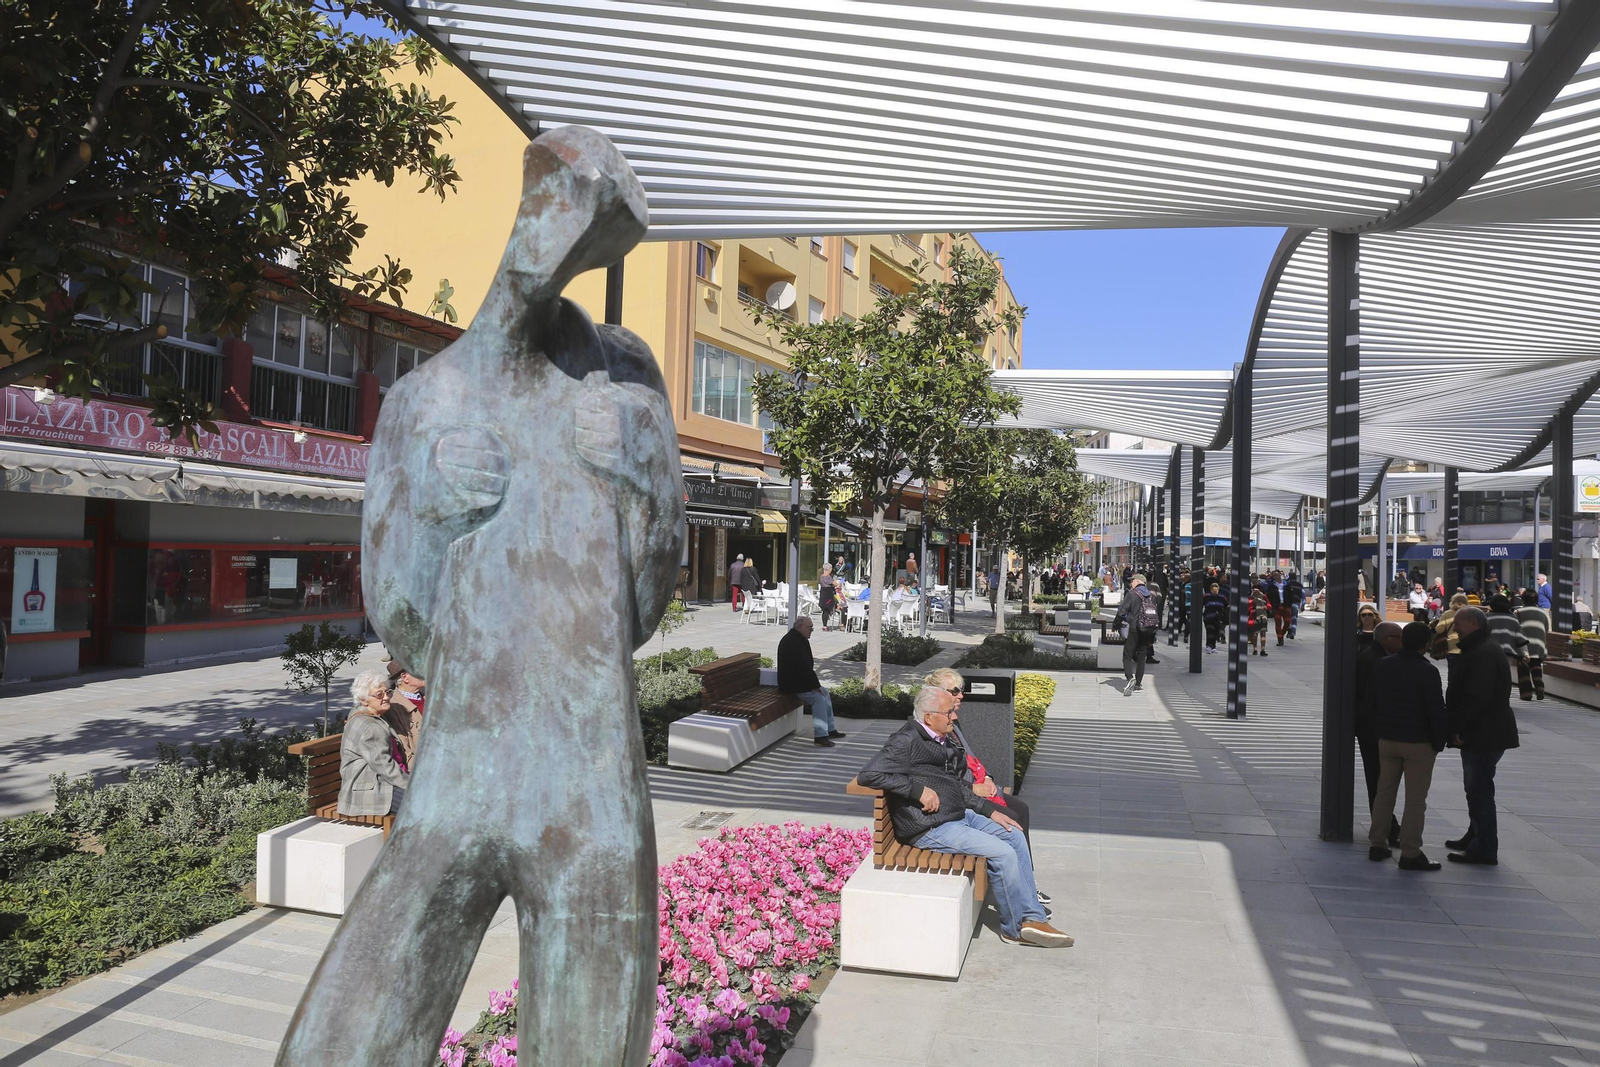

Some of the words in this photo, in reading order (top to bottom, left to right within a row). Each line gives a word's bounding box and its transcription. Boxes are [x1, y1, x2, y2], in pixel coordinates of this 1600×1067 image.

[6, 393, 145, 438] LAZARO
[109, 437, 141, 449] TEL:
[148, 442, 170, 453] 622
[173, 445, 188, 455] 89
[1432, 548, 1445, 557] BBV
[1490, 547, 1508, 556] BBVA
